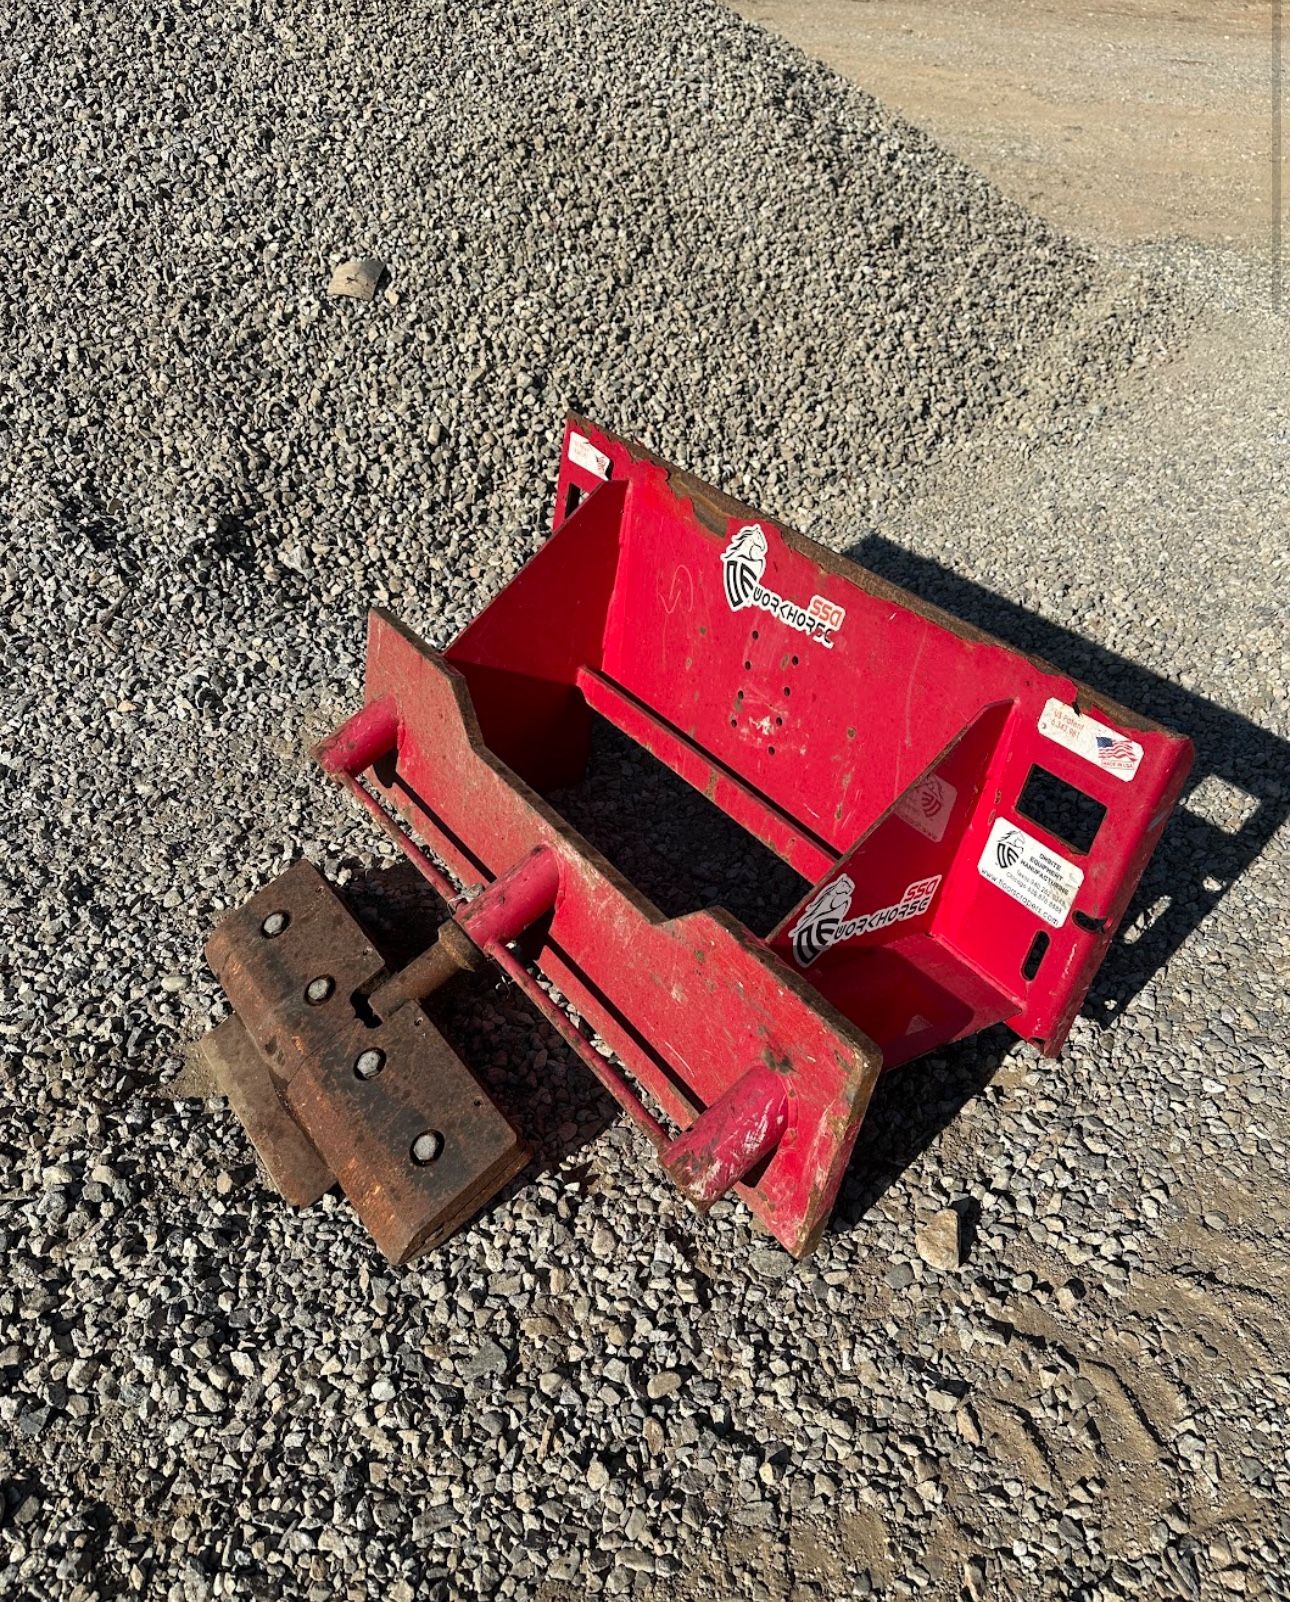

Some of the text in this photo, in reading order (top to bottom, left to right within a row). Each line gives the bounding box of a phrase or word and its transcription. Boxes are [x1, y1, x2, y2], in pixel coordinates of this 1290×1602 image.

[1021, 859, 1069, 895] MANUFACTURING
[1030, 856, 1063, 880] EQUIPMENT
[1039, 853, 1062, 871] ONSITE
[981, 869, 1058, 926] www.floorscrapers.com
[834, 896, 930, 940] WORKHORSE
